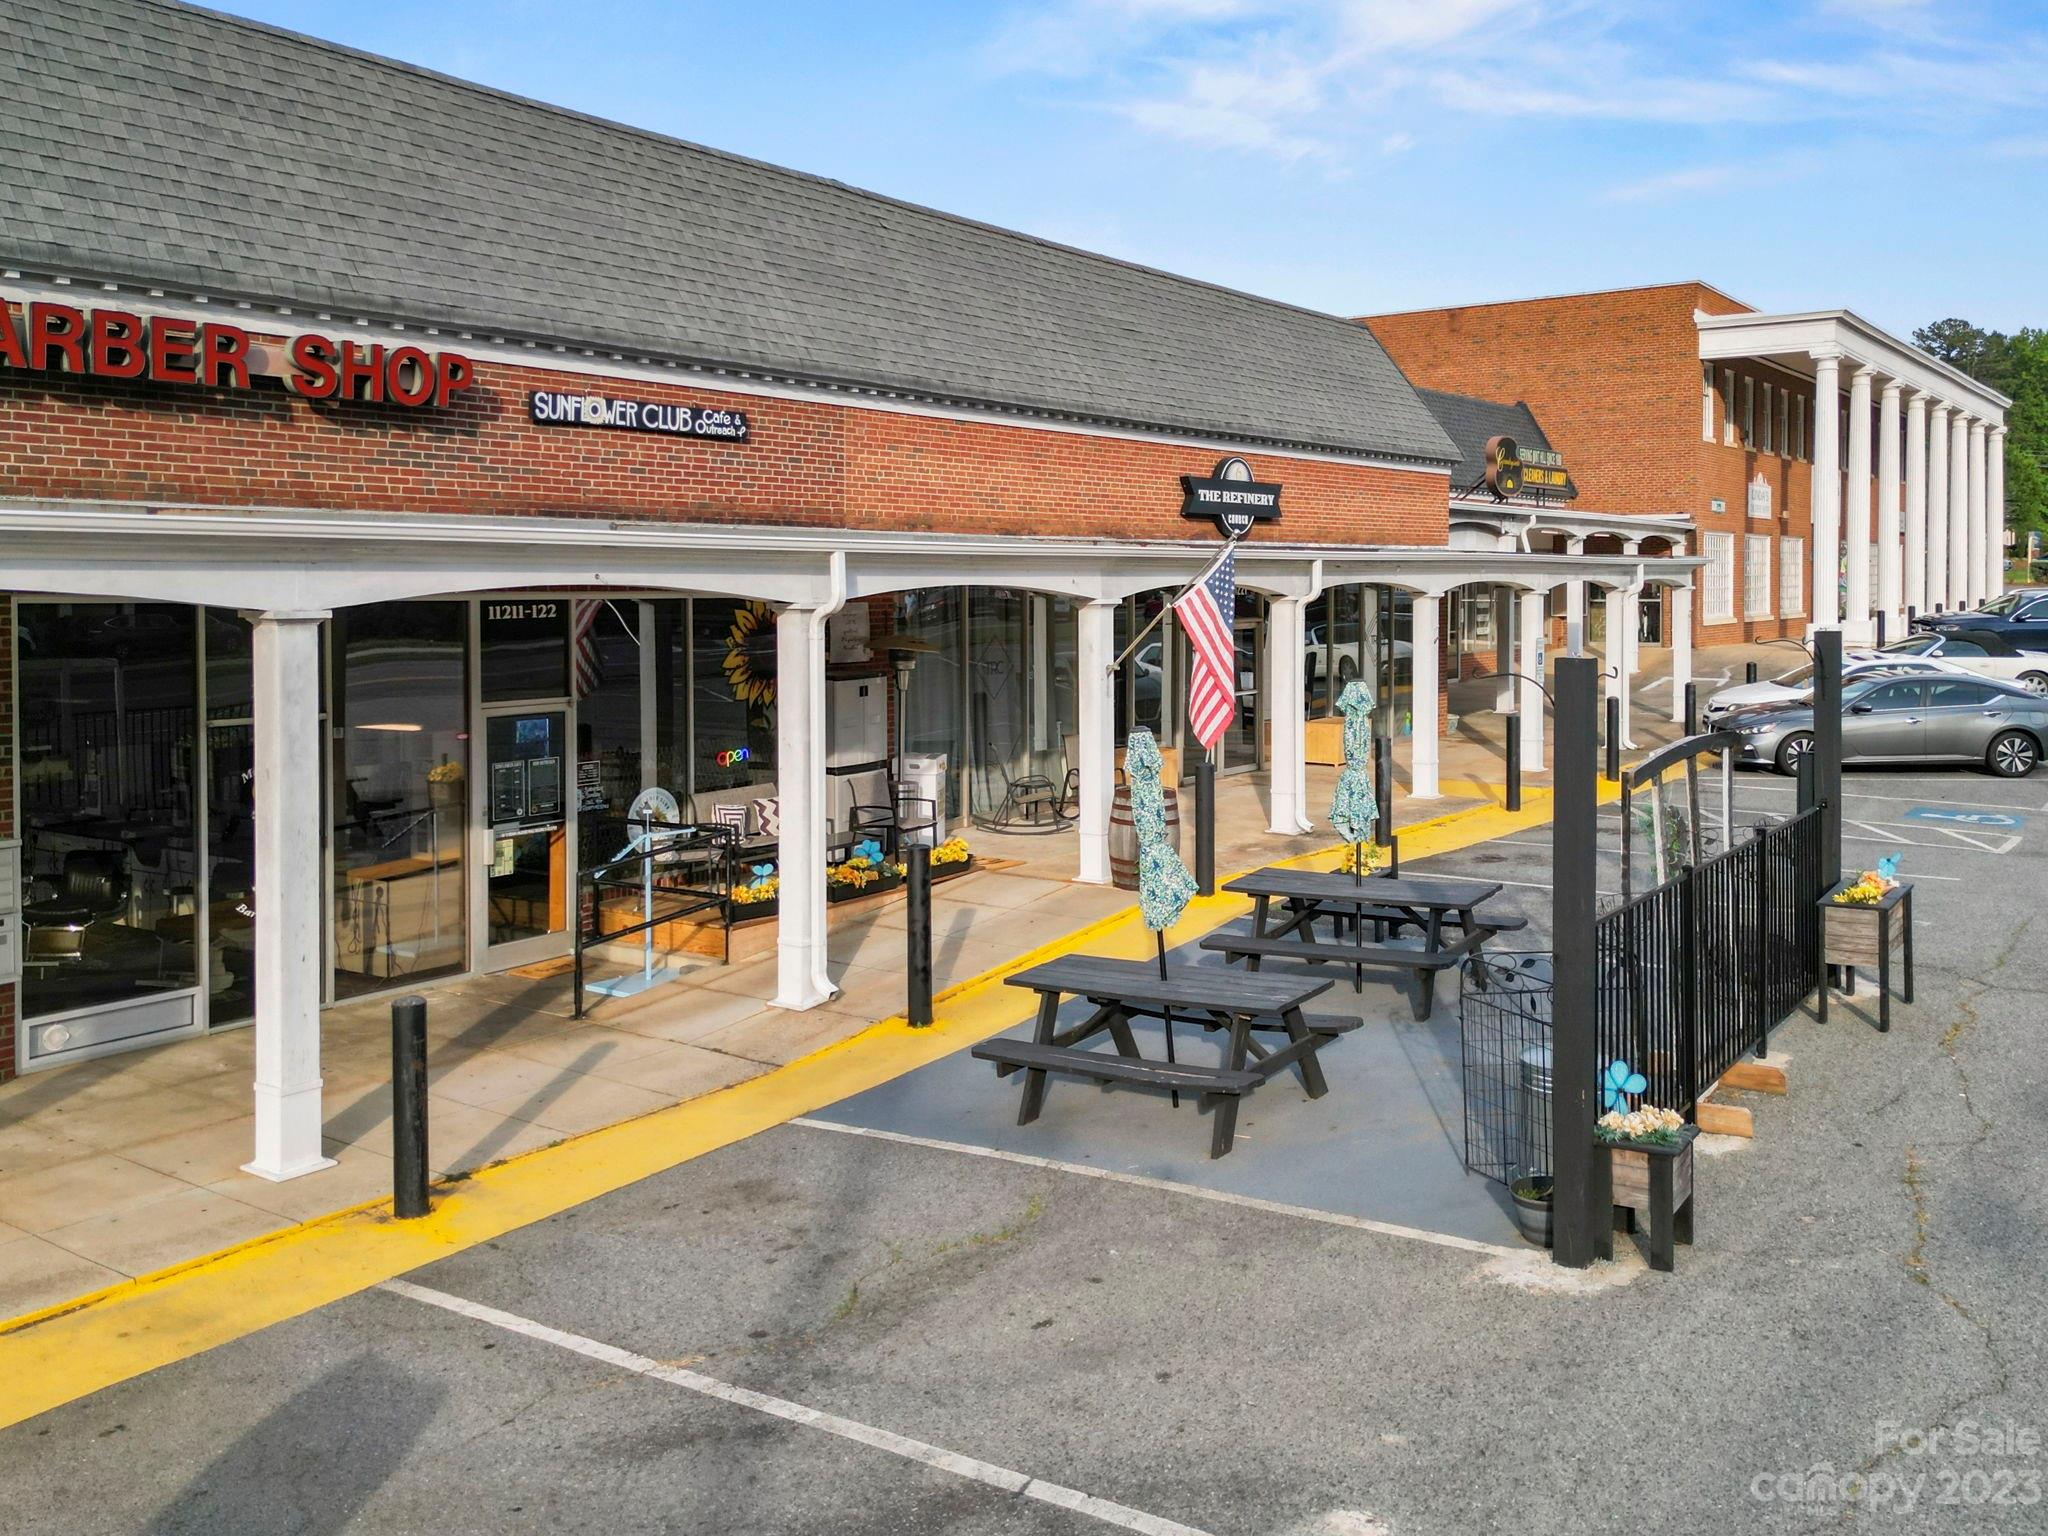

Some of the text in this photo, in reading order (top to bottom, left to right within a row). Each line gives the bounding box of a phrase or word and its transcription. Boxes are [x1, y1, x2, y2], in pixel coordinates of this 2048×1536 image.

[292, 333, 474, 408] SHOP
[534, 391, 692, 433] SUNFLOWER CLUB
[702, 409, 742, 425] Cafe &
[694, 419, 736, 437] Outreach
[1198, 489, 1275, 506] THE REFINERY
[1227, 514, 1249, 525] CHURCH
[488, 604, 557, 620] 11211-122
[715, 748, 749, 767] open
